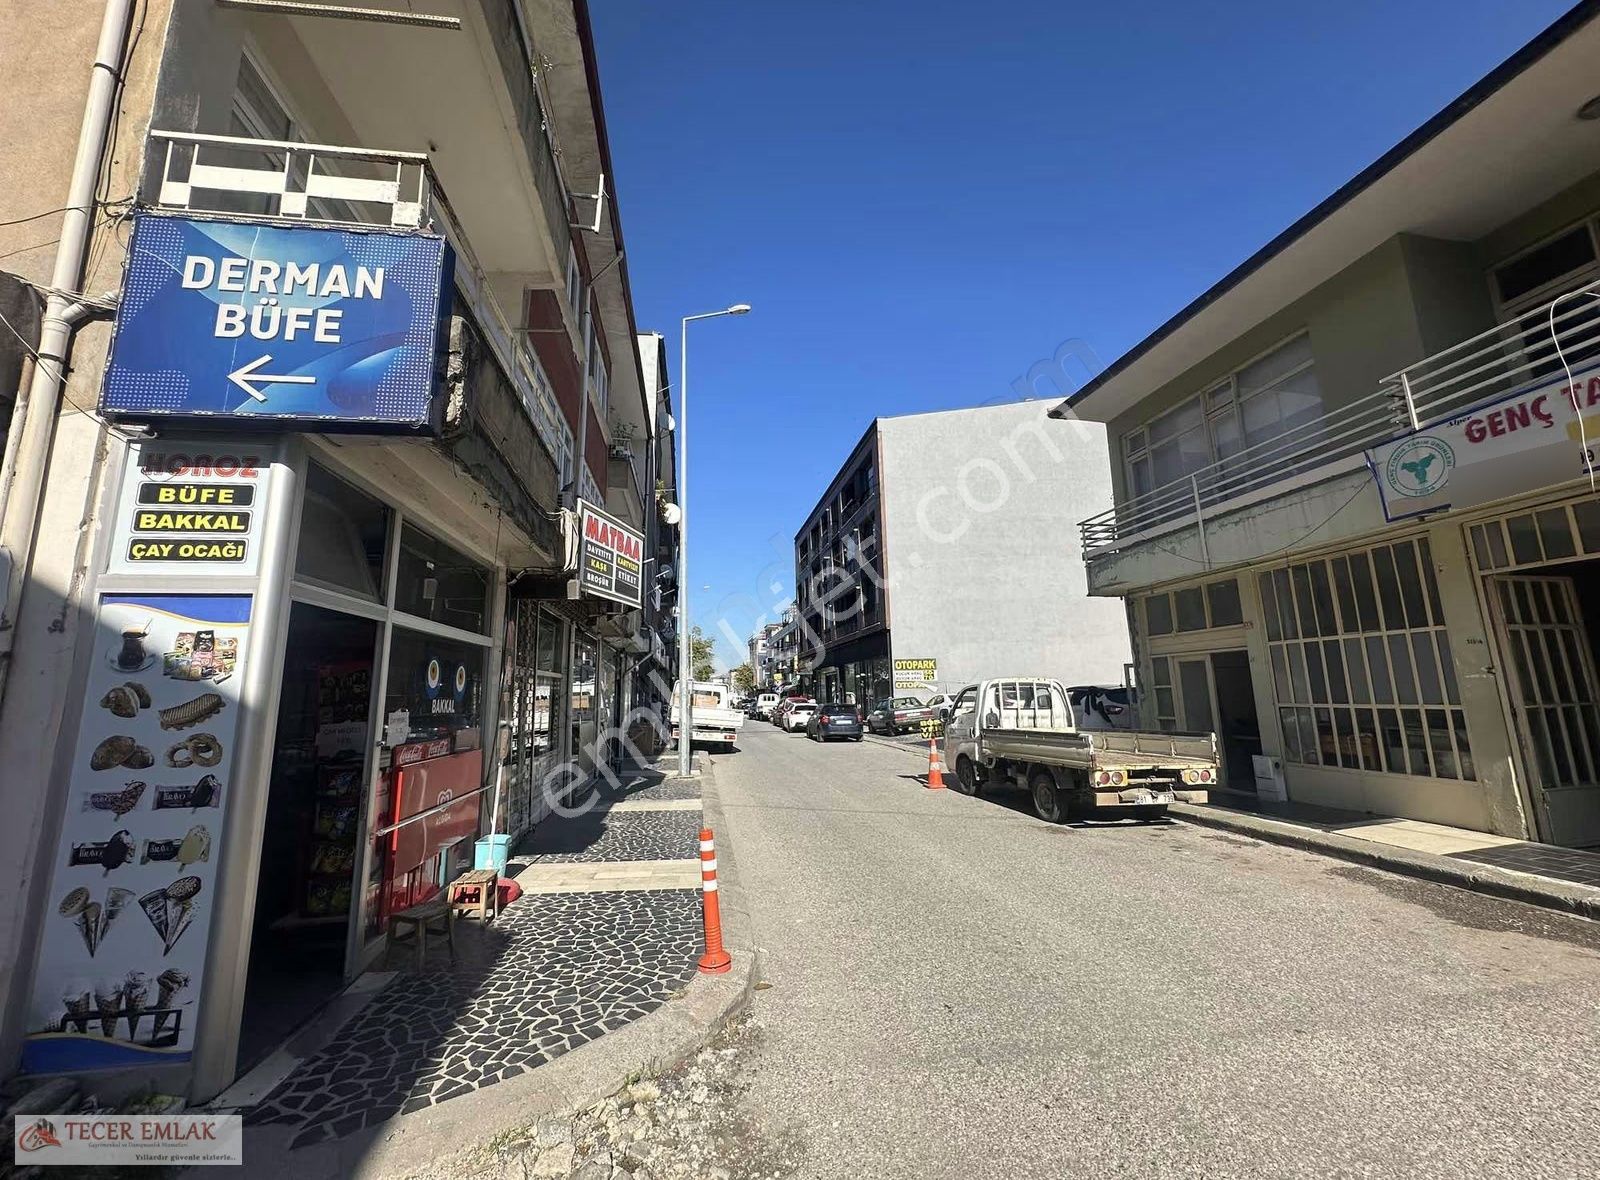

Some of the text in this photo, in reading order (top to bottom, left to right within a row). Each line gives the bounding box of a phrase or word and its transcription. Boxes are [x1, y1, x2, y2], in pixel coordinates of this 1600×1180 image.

[181, 255, 386, 300] DERMAN
[214, 298, 344, 344] BÜFE
[1464, 394, 1555, 444] GENÇ
[144, 453, 259, 478] HOROZ
[158, 485, 236, 504] BÜFE
[138, 513, 246, 531] BAKKAL
[586, 514, 641, 561] MATBAA
[132, 541, 244, 559] ÇAY OCAĞI
[590, 558, 608, 572] KAŞE
[587, 573, 609, 587] BROŞÜR
[618, 570, 637, 585] ETİKET
[895, 660, 936, 670] OTOPARK
[431, 697, 456, 715] BAKKAL
